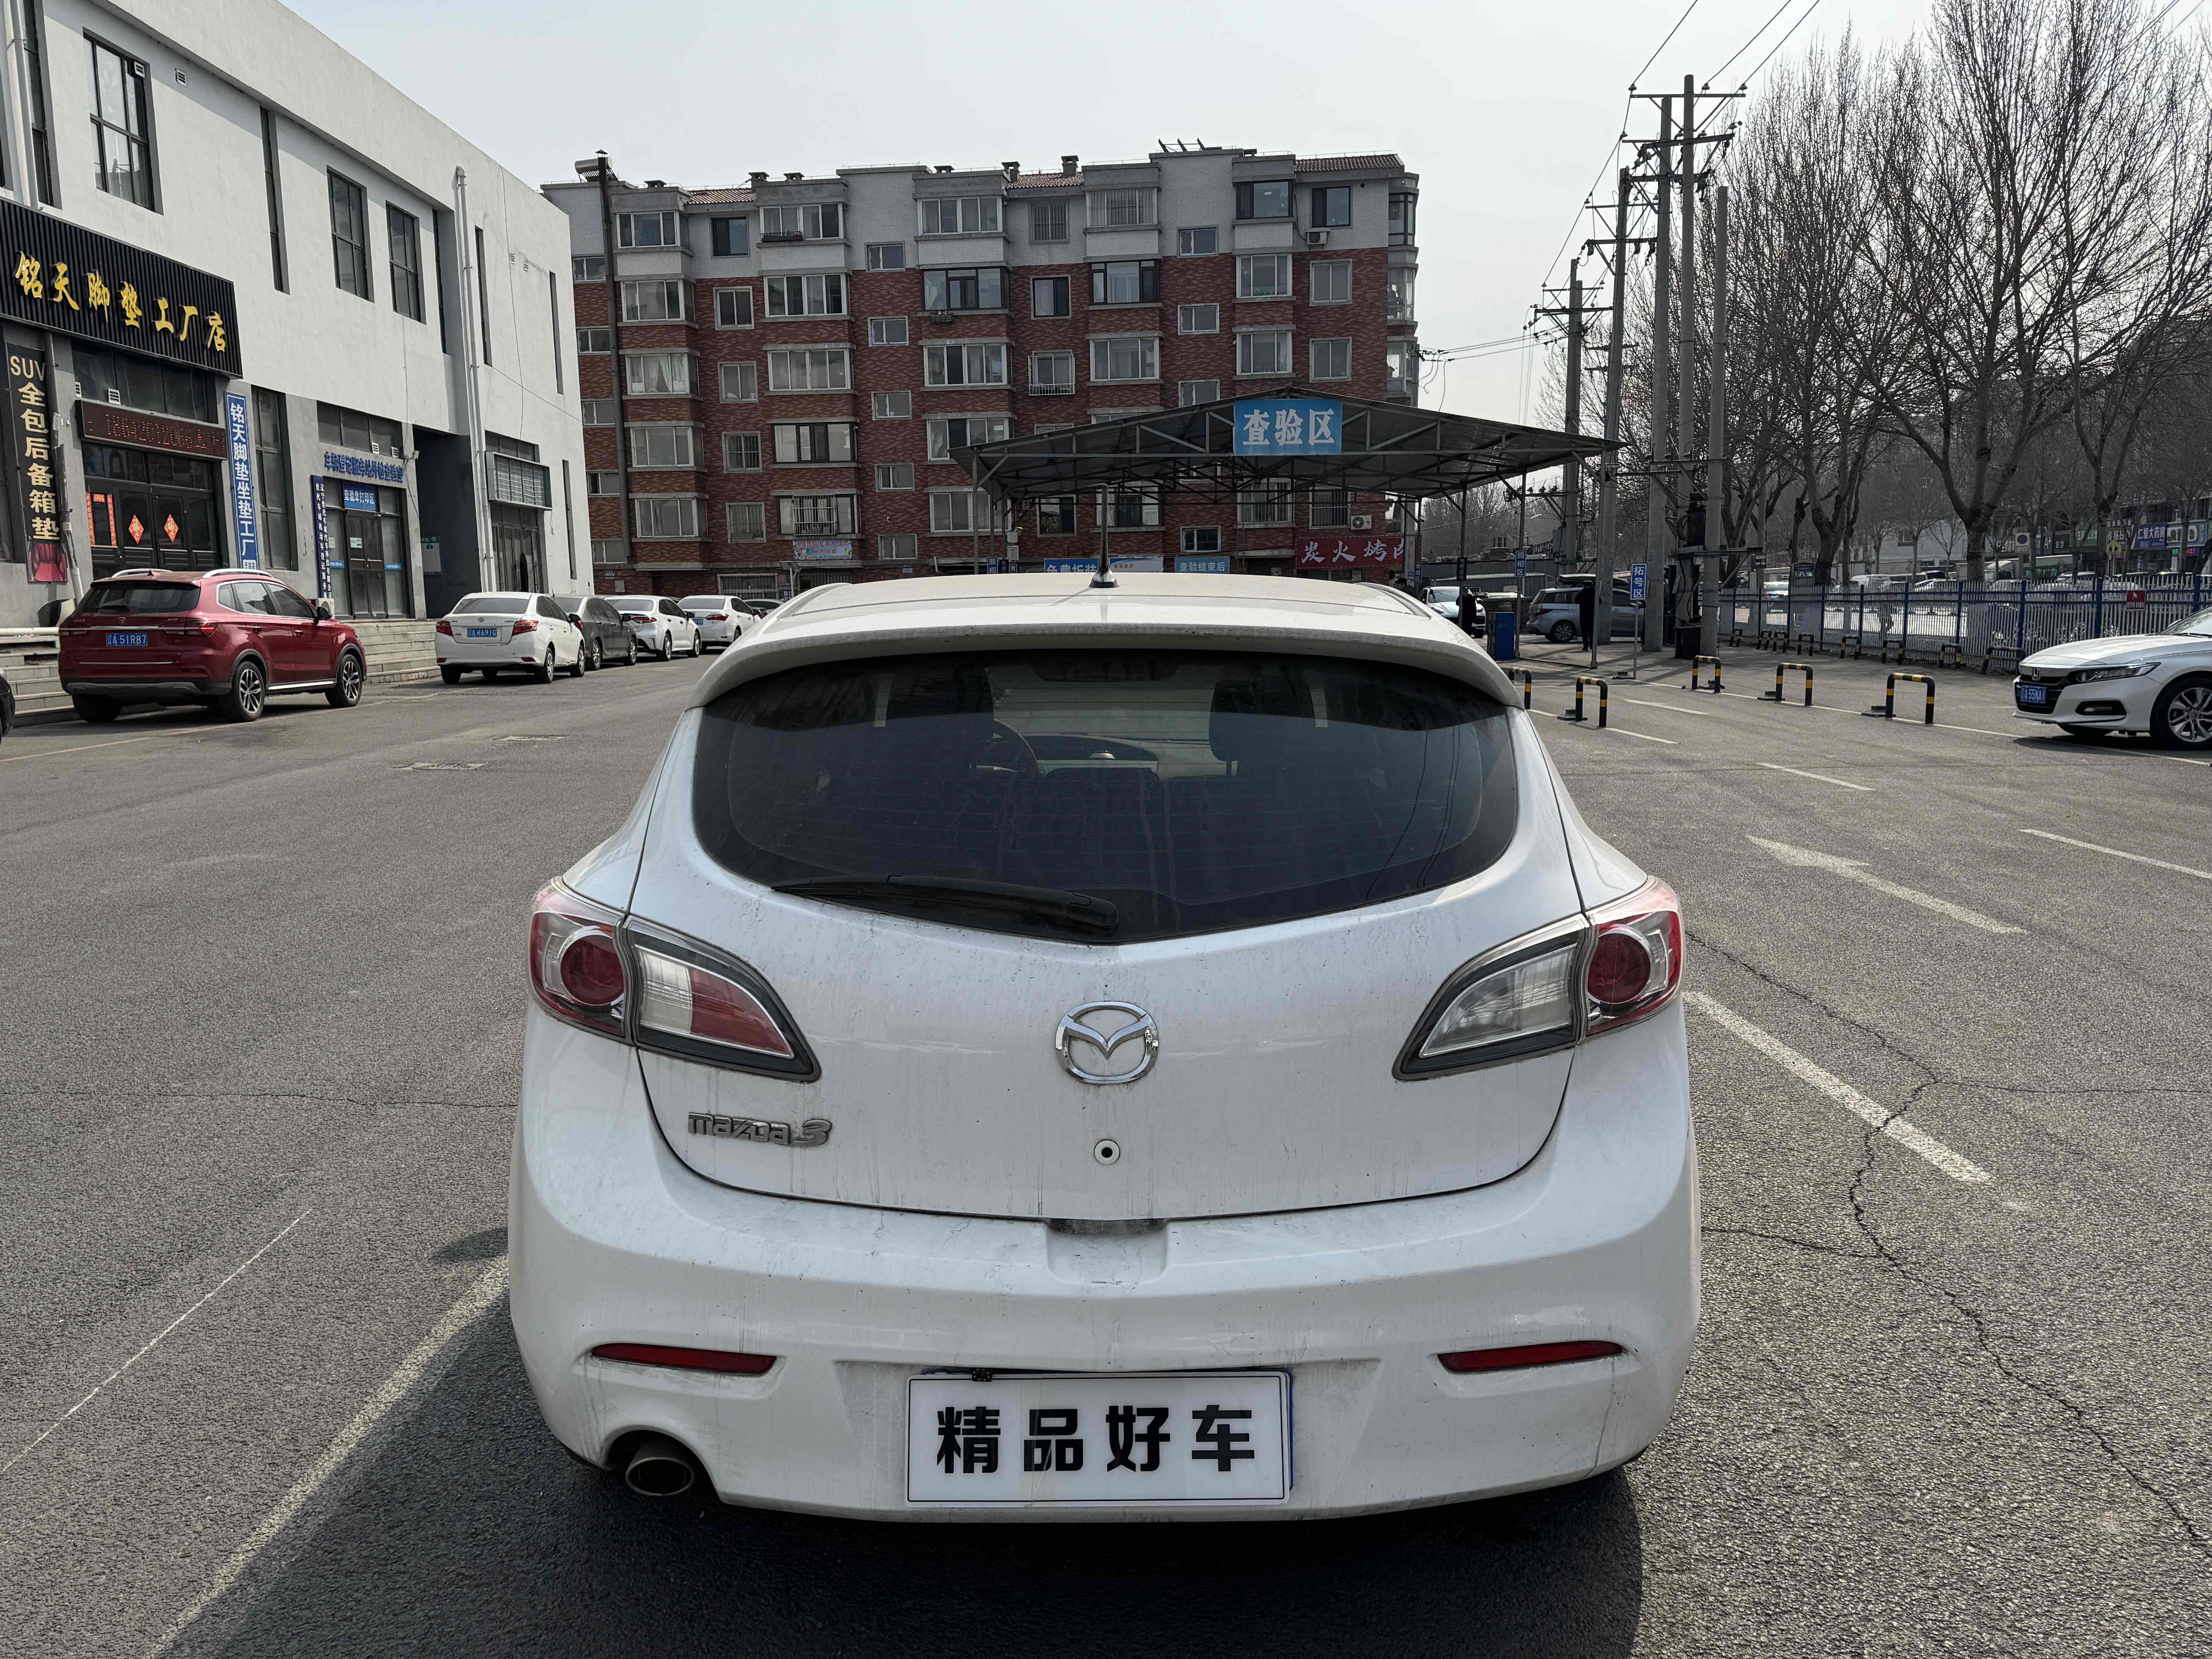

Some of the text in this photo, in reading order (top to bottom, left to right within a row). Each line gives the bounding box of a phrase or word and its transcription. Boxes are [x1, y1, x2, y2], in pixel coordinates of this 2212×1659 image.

[15, 251, 226, 352] 铭天脚垫工厂店
[10, 356, 45, 381] SUV
[1242, 409, 1335, 446] 查验区
[18, 382, 60, 541] 全包后备箱垫
[230, 402, 254, 556] 铭天脚垫坐垫工厂
[2138, 526, 2166, 540] 仁爱大药房
[1179, 562, 1225, 572] 查验结束后
[1633, 565, 1644, 598] 拓号区
[936, 1405, 1255, 1474] 精品好车
